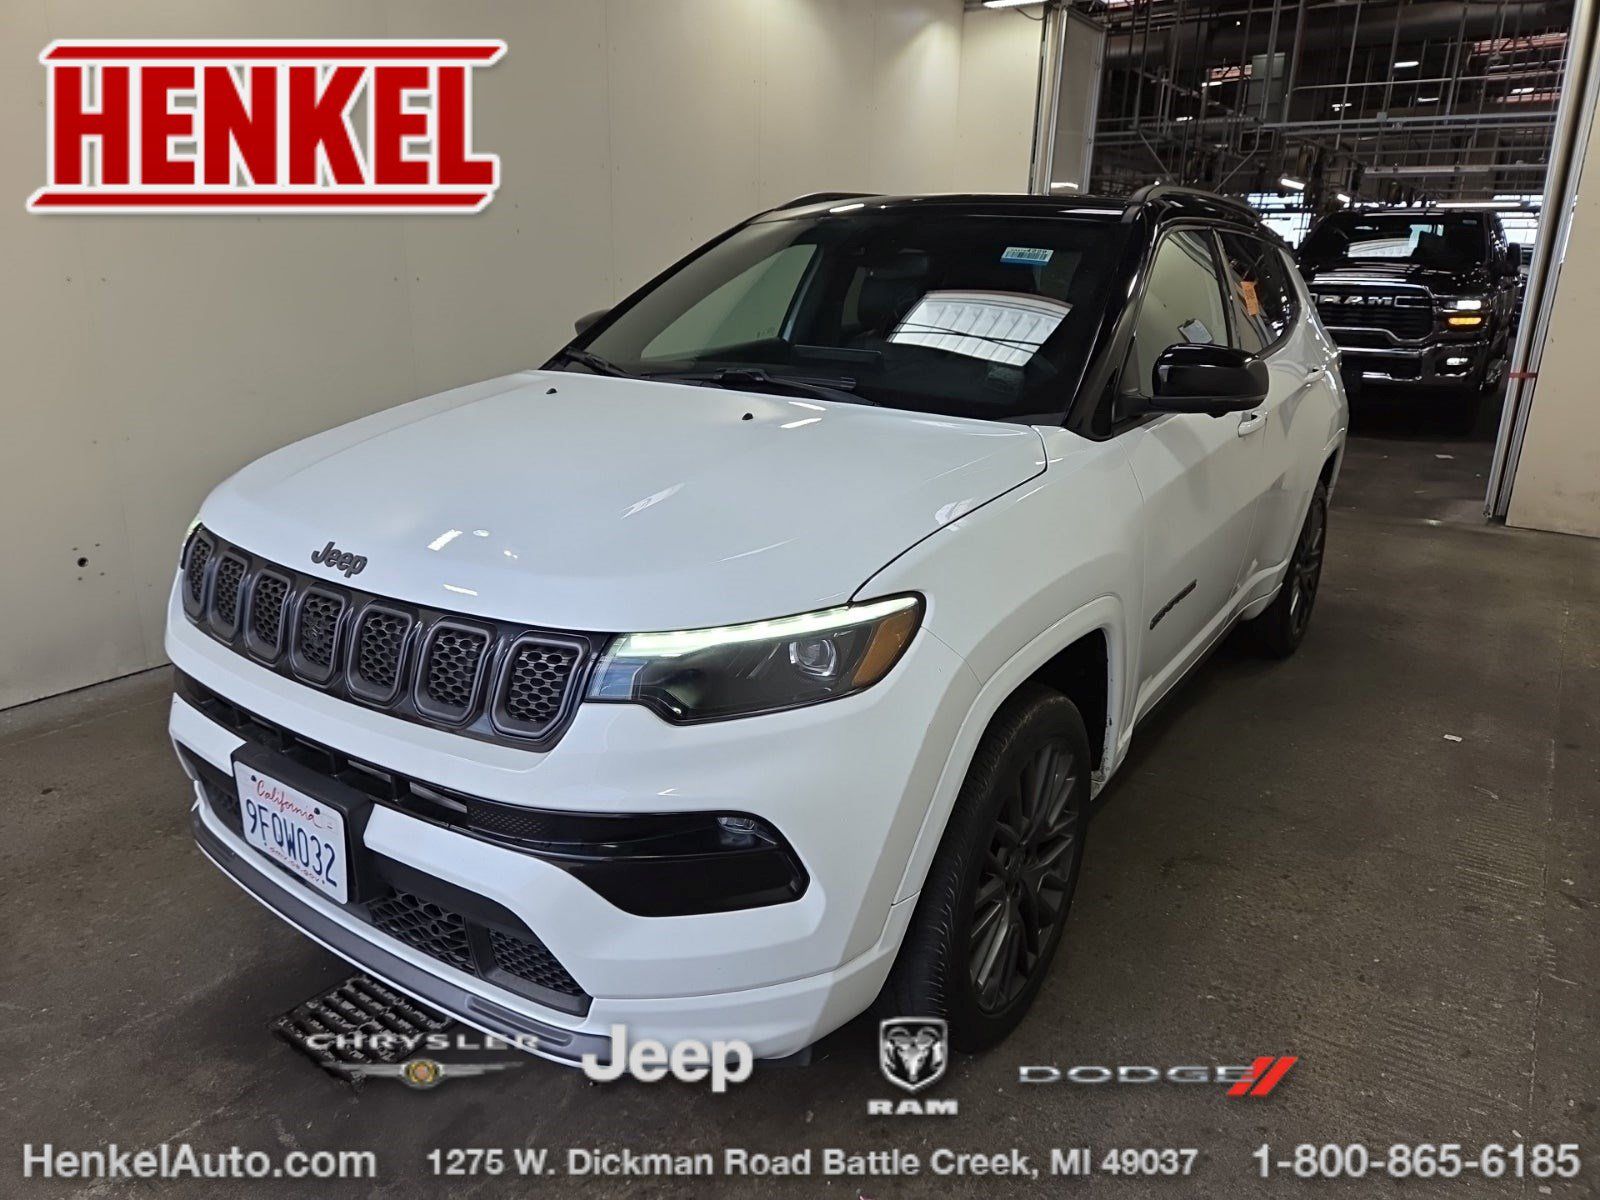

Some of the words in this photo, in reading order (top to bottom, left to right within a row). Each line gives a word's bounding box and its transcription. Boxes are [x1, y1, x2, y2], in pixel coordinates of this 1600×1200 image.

[1319, 294, 1393, 305] RAM
[311, 541, 368, 578] Jeep
[256, 779, 315, 822] California
